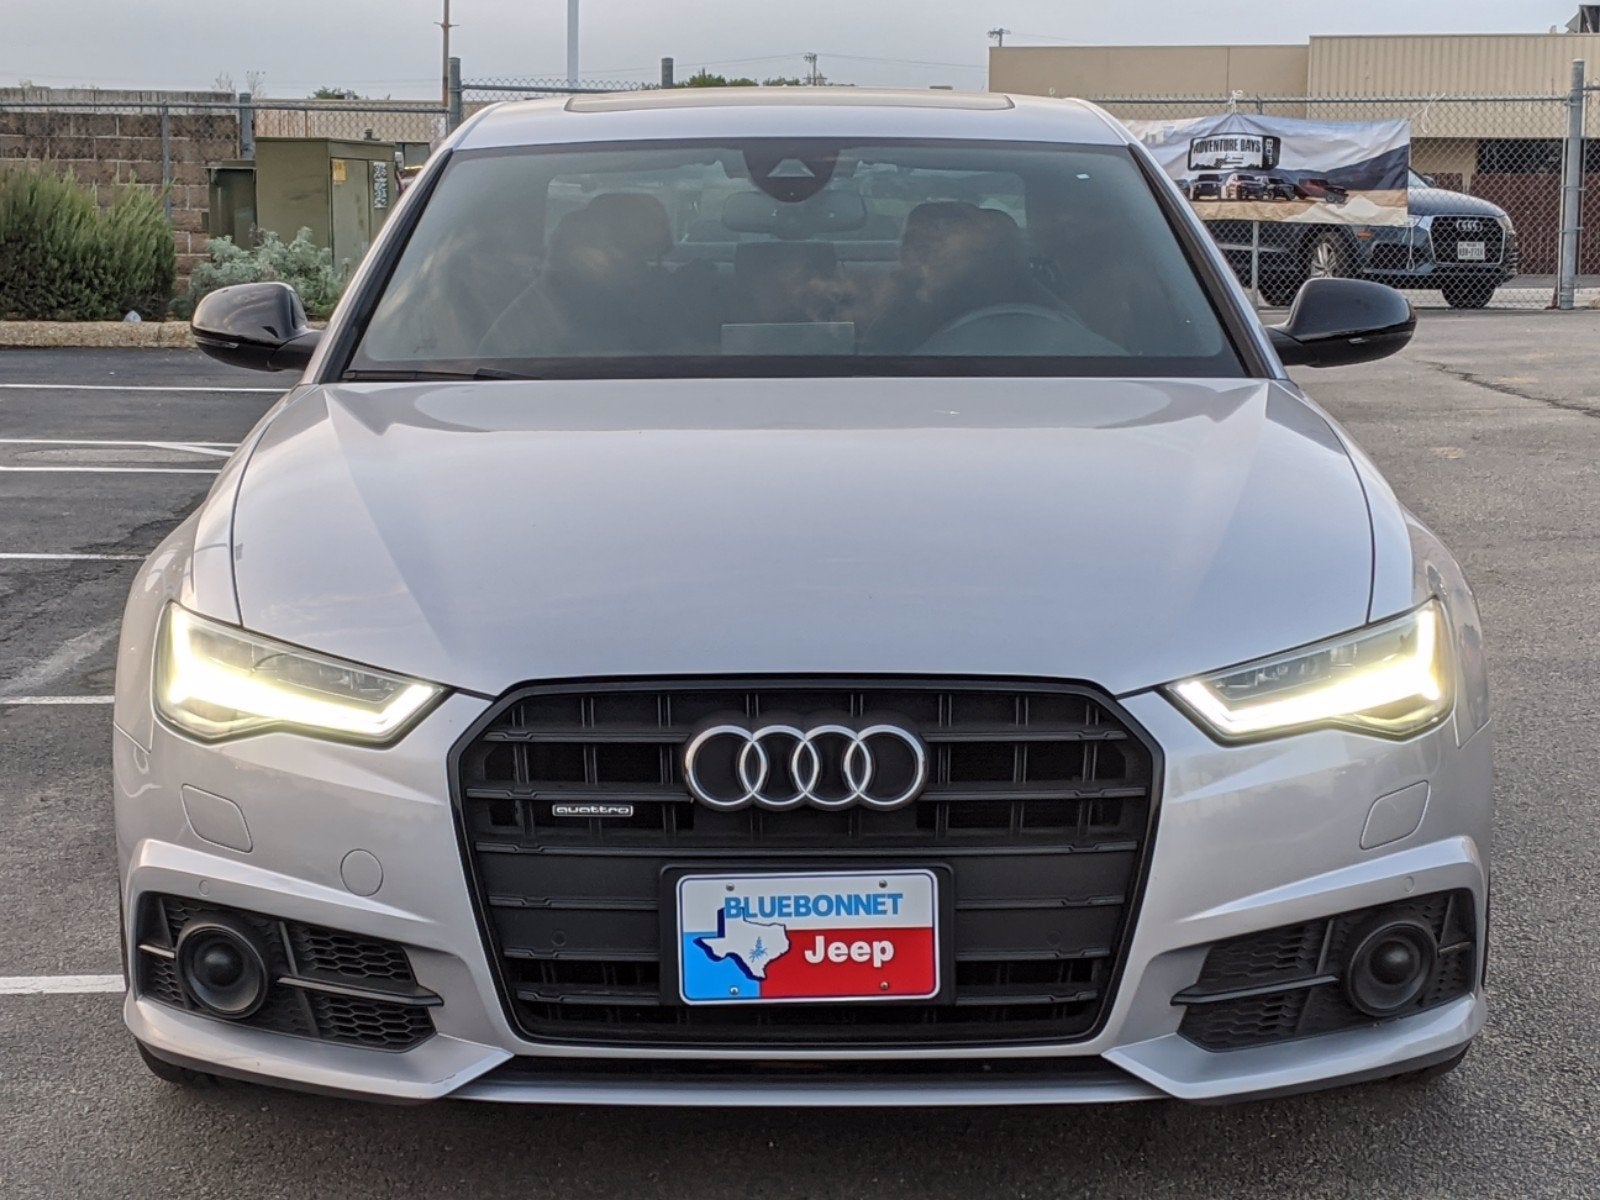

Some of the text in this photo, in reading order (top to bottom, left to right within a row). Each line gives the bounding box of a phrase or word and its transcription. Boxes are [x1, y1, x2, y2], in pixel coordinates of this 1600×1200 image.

[1193, 138, 1261, 154] ADVENTURE DAYS
[556, 805, 629, 815] quattro
[725, 893, 904, 918] BLUEBONNET
[804, 935, 894, 968] Jeep
